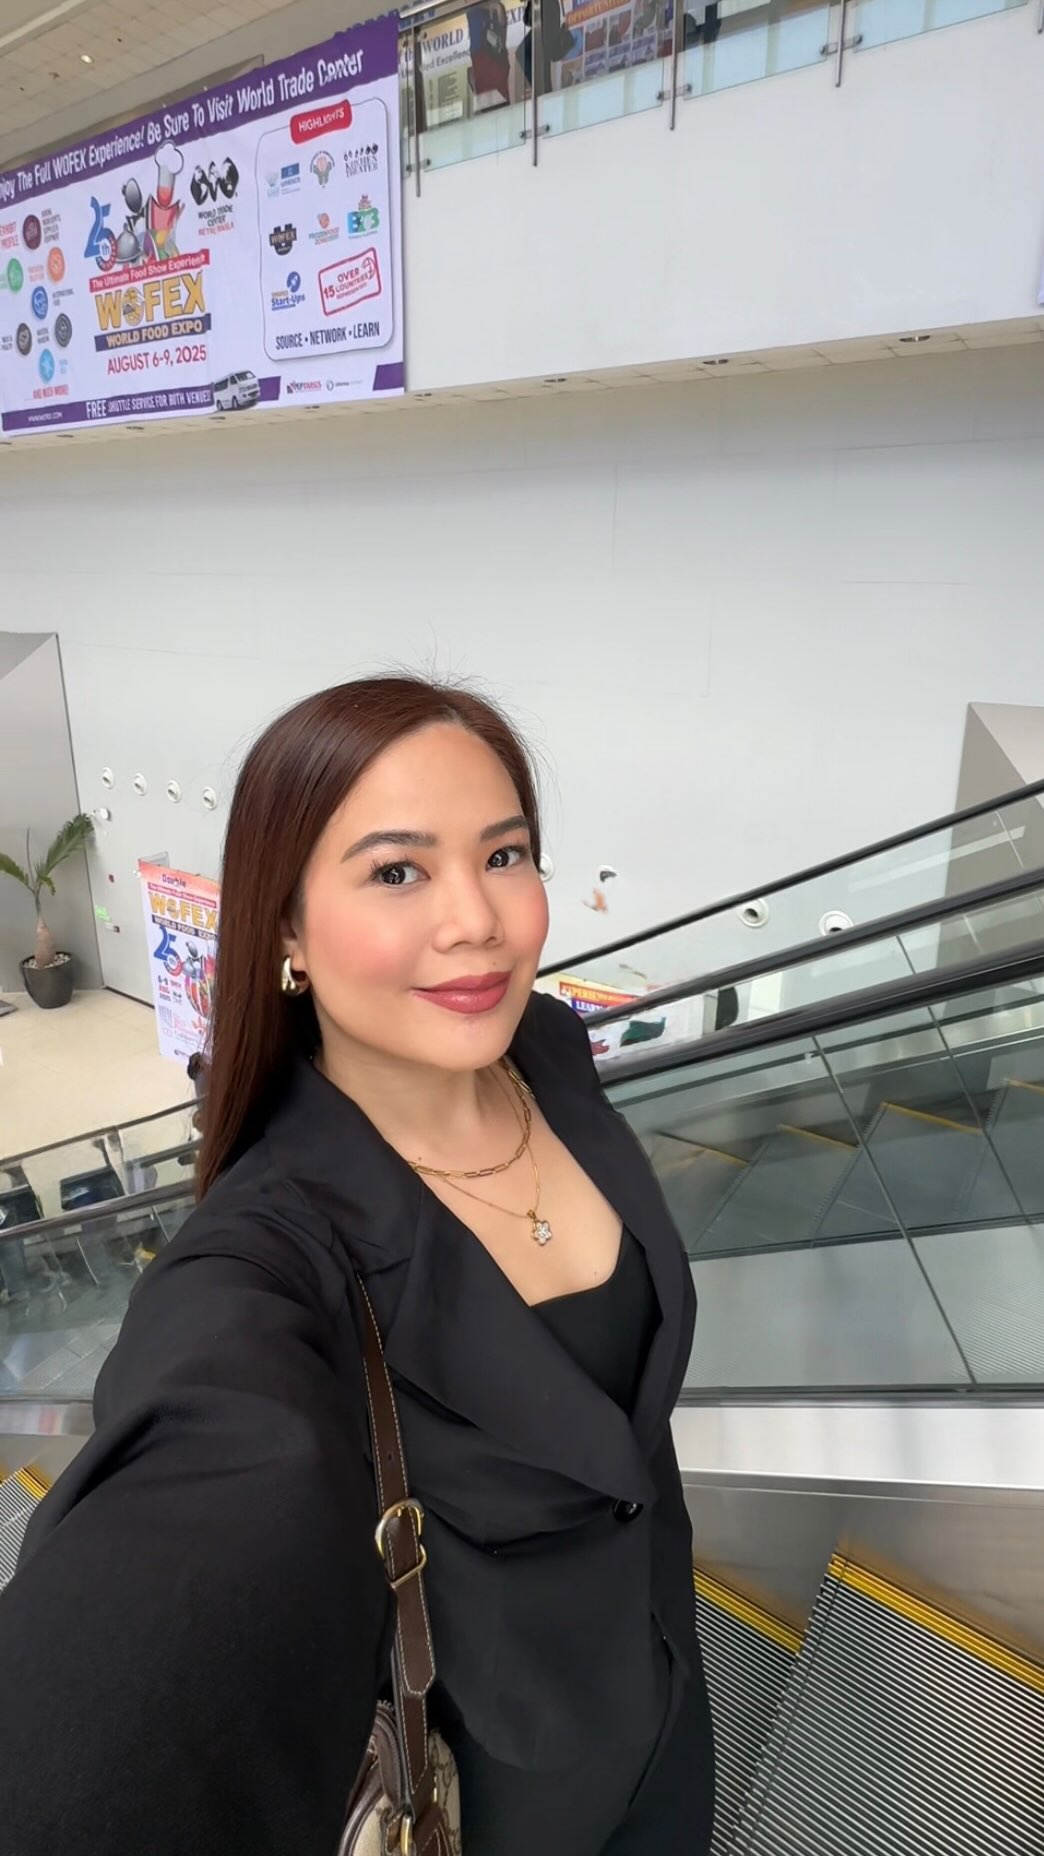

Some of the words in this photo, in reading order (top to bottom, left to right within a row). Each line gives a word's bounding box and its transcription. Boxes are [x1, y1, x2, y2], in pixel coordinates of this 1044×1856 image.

[422, 28, 464, 54] WORLD
[436, 49, 471, 69] Excellenc
[0, 175, 16, 202] njoy
[17, 170, 33, 192] The
[34, 161, 51, 187] Full
[52, 148, 87, 180] WOFEX
[89, 126, 145, 168] Experience!
[147, 121, 162, 145] Be
[164, 111, 190, 138] Sure
[192, 102, 205, 127] To
[207, 94, 234, 123] Visit
[237, 79, 275, 113] World
[278, 68, 315, 101] Trade
[337, 267, 360, 282] OVER
[94, 270, 206, 331] WOFEX
[323, 285, 336, 300] 15
[106, 331, 140, 348] WORLD
[141, 324, 169, 342] FOOD
[171, 319, 203, 336] EXPO
[275, 333, 304, 350] SOURCE
[309, 327, 347, 346] NETWORK
[353, 321, 380, 339] LEARN
[107, 352, 150, 375] AUGUST
[152, 349, 173, 368] 6-9,
[175, 345, 206, 364] 2025
[85, 399, 107, 419] FREE
[168, 394, 186, 407] BOTH
